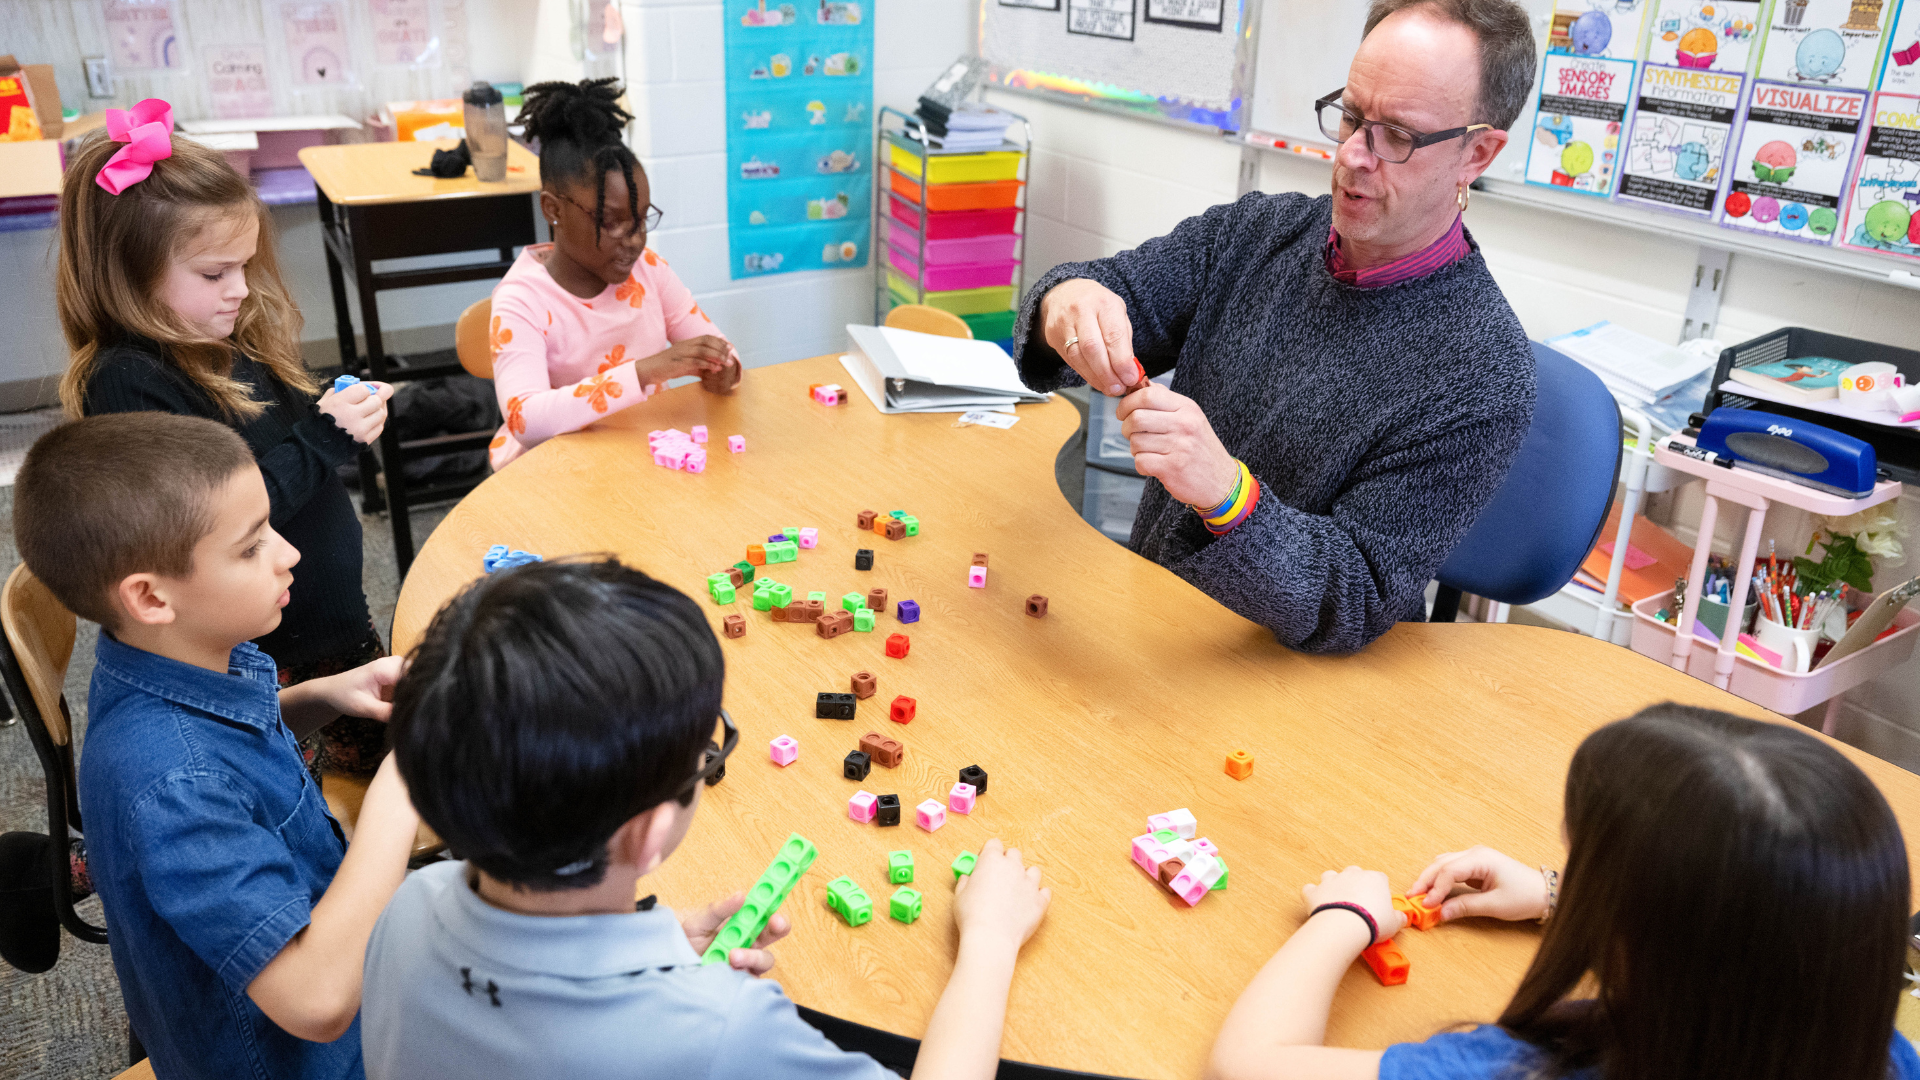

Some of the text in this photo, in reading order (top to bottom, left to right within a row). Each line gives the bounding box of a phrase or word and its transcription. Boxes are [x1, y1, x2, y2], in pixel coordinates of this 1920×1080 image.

[1842, 30, 1879, 39] Important?
[212, 60, 264, 75] Calming
[1570, 58, 1606, 71] Create
[1558, 67, 1616, 86] SENSORY
[1645, 68, 1741, 94] SYNTHESIZE
[1558, 82, 1610, 100] IMAGES
[1756, 87, 1862, 116] VISUALIZE
[1767, 425, 1793, 437] EXPO
